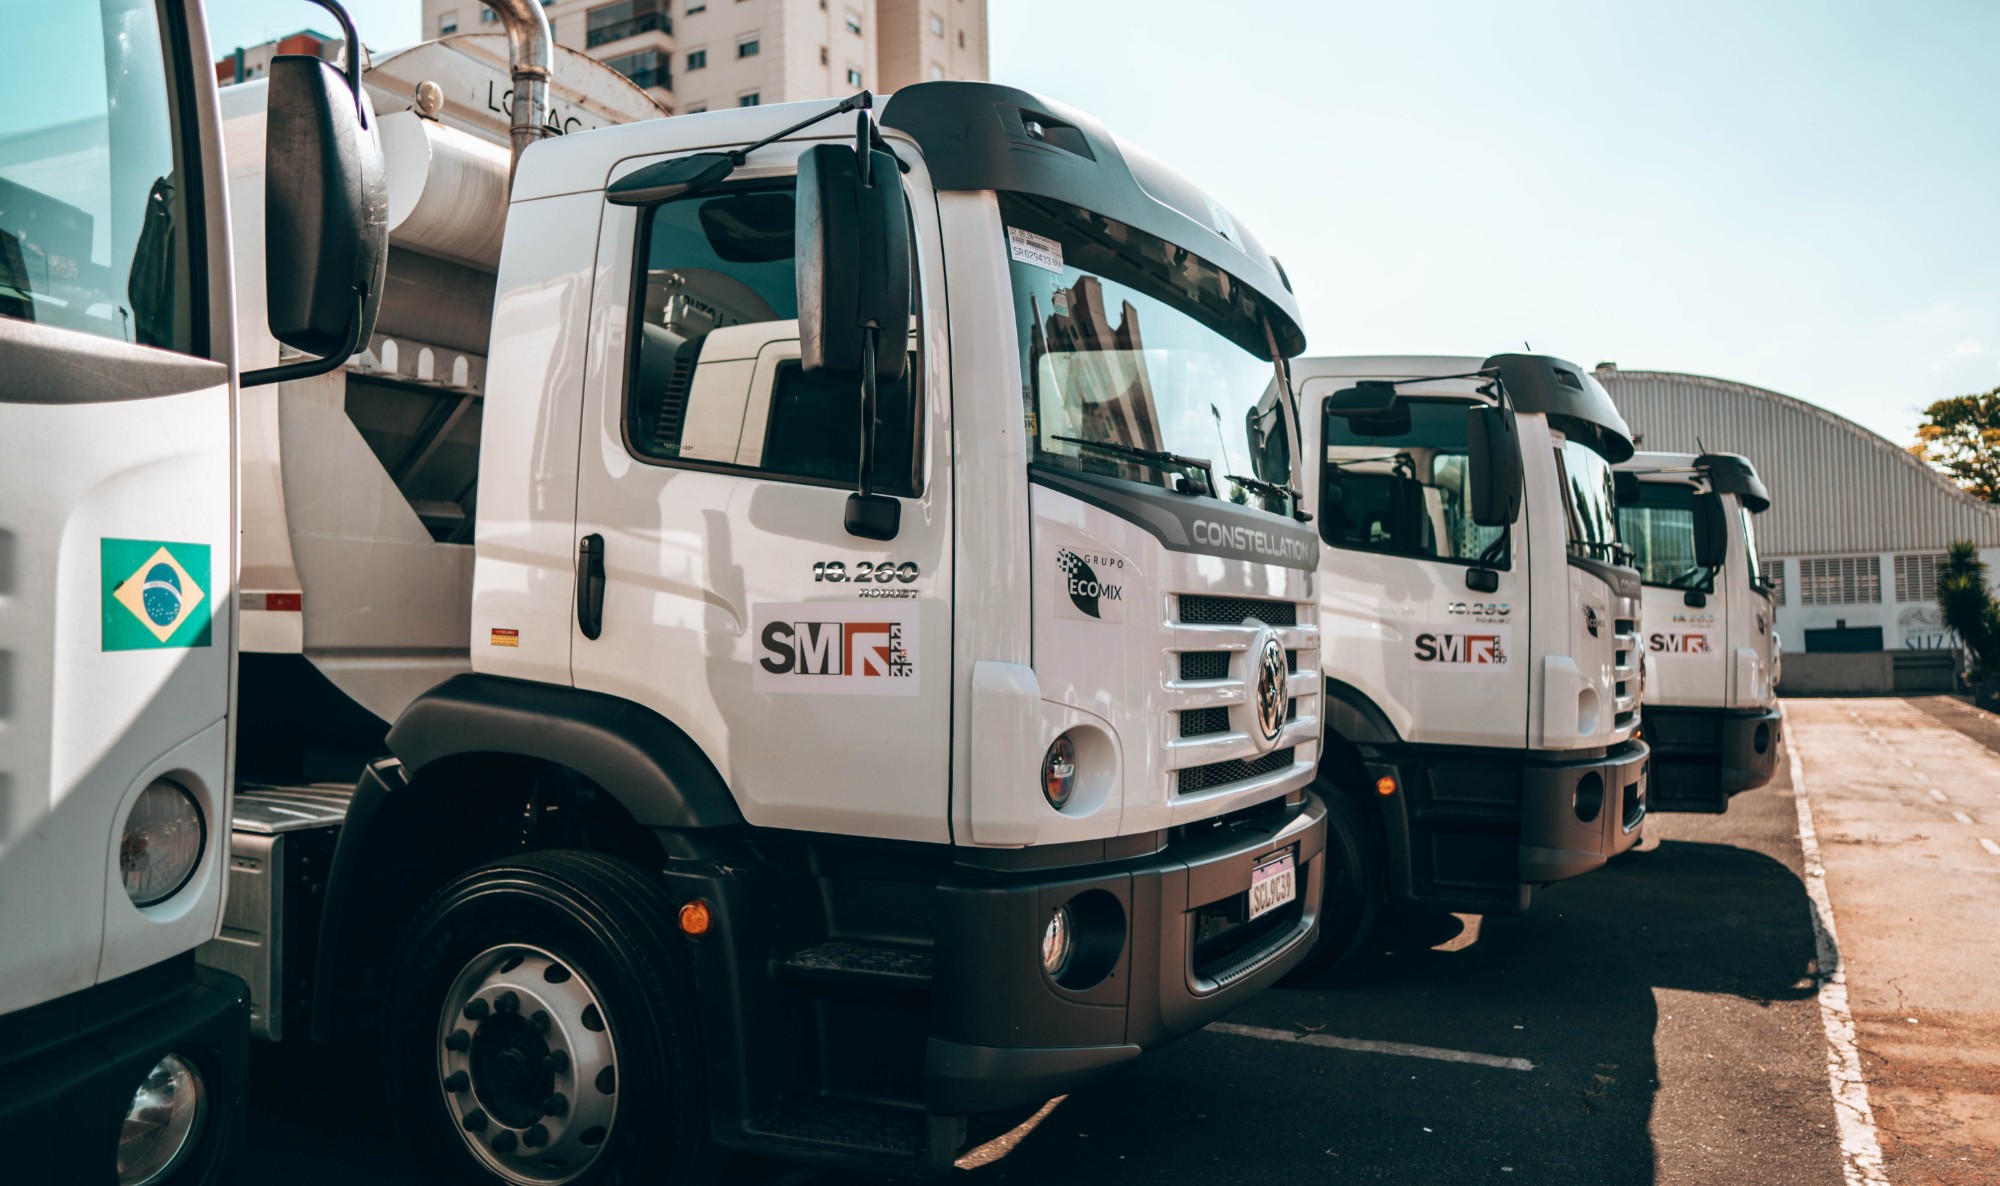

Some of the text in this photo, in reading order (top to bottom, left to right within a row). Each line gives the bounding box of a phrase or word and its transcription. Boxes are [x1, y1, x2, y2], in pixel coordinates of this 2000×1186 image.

[1192, 519, 1309, 562] CONSTELLATION
[812, 561, 921, 584] 18.260
[1084, 554, 1124, 569] GRUPO
[858, 588, 919, 599] ROBUST
[1254, 871, 1291, 912] SCL9C39
